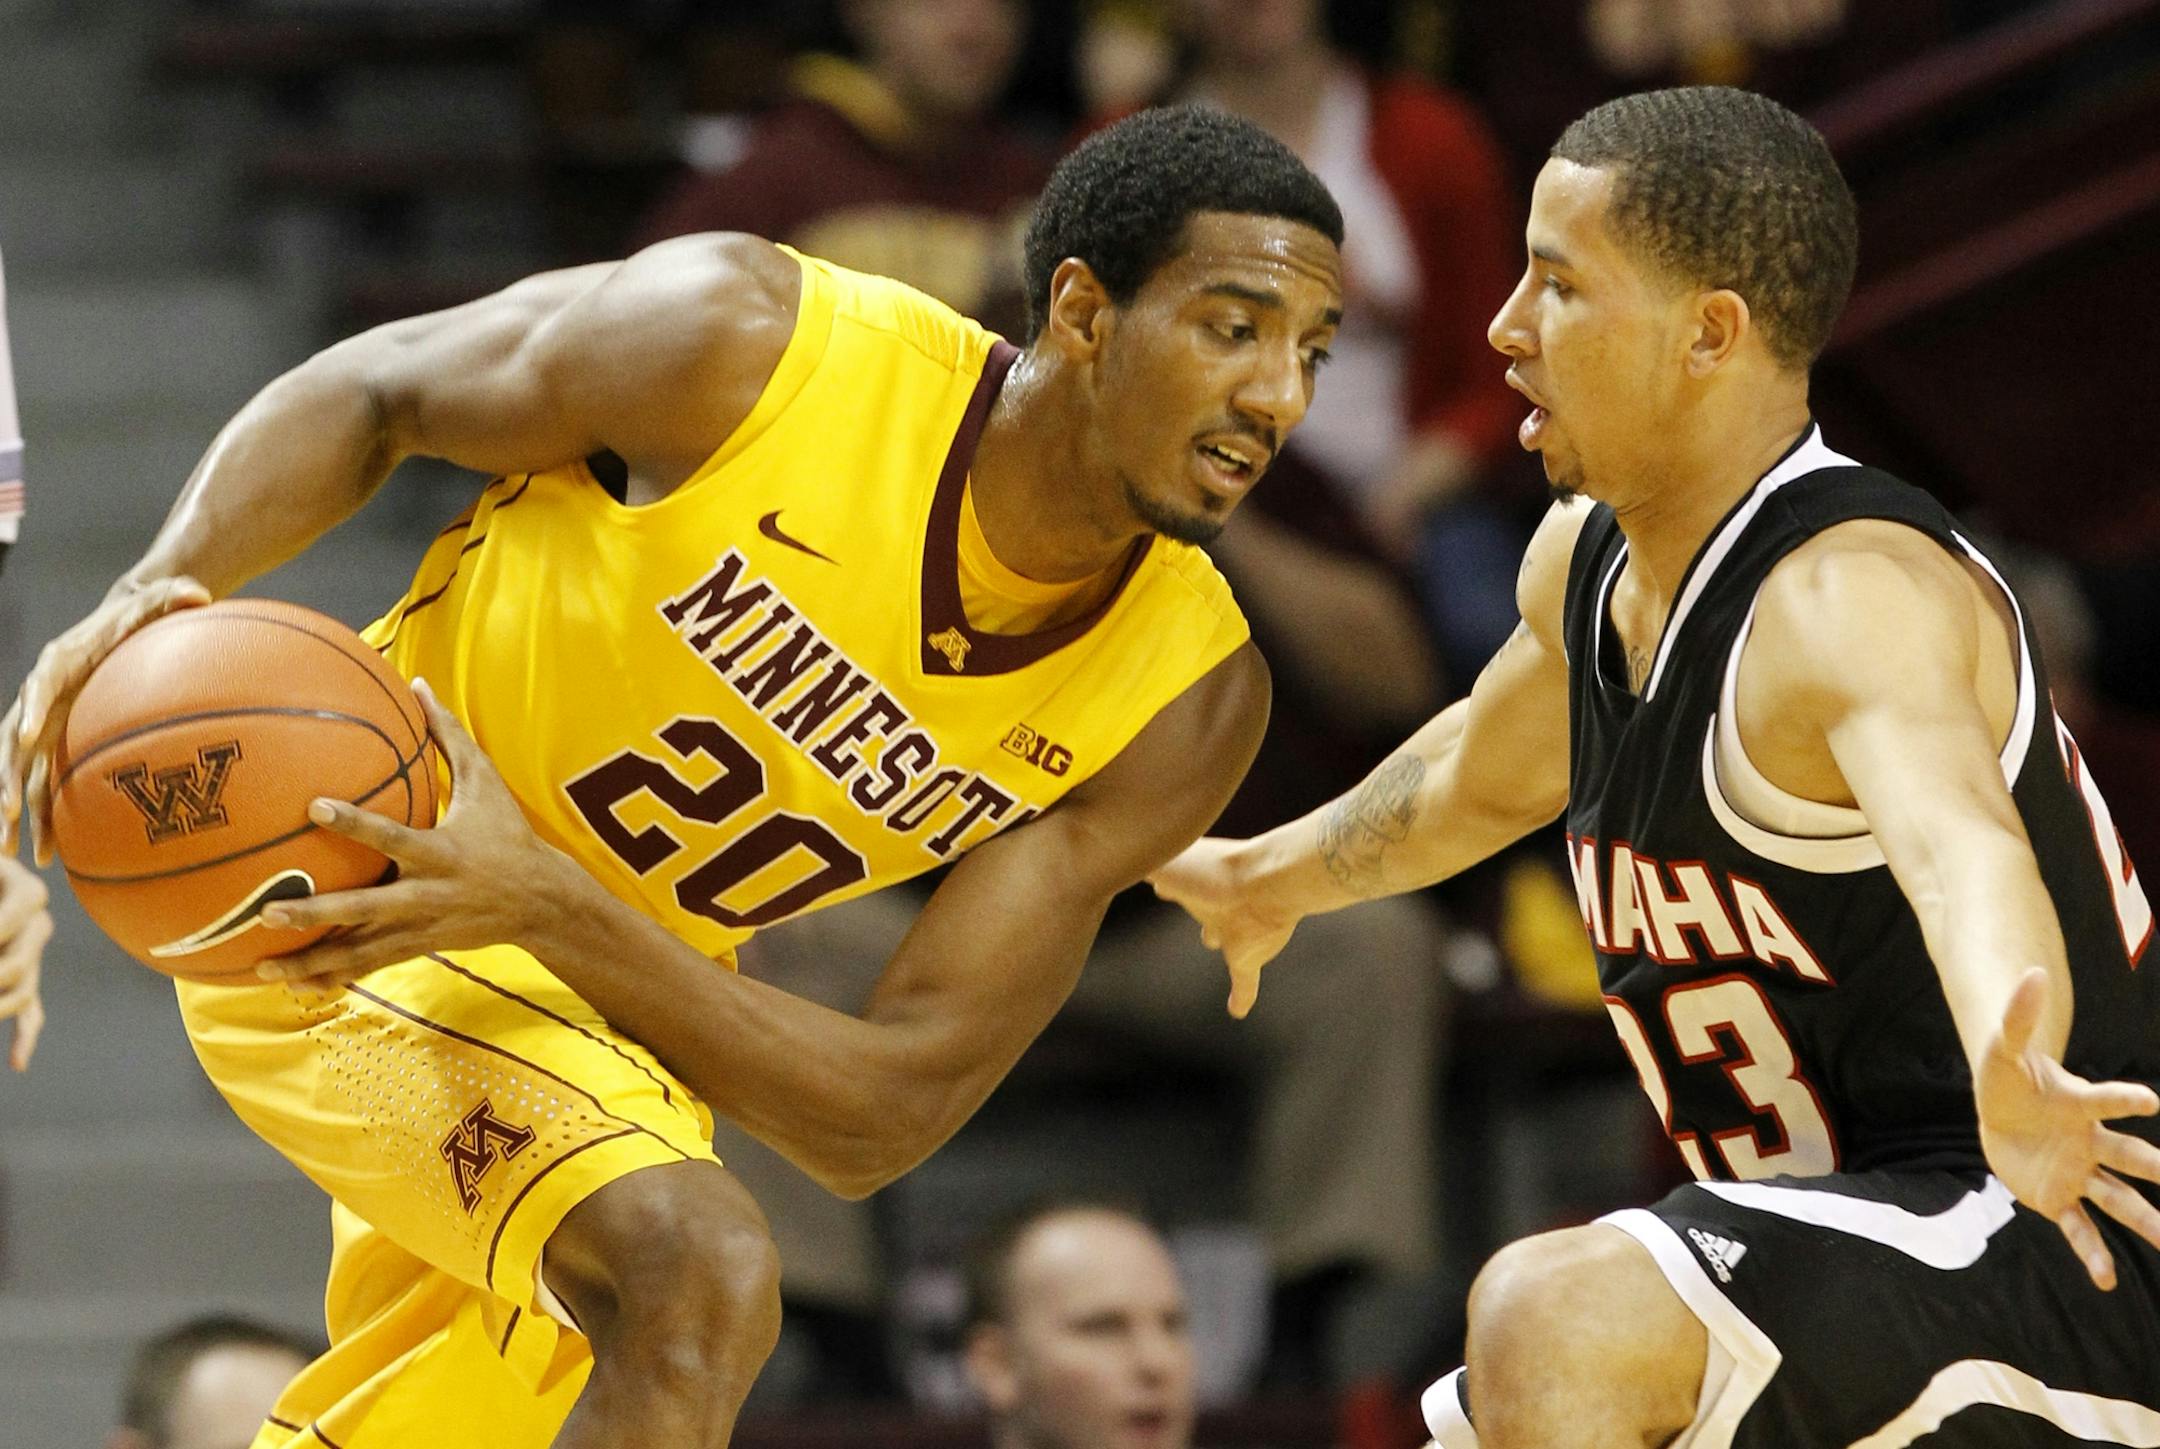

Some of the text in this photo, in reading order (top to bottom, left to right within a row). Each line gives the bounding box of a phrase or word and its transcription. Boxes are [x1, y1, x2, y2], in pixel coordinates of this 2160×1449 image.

[656, 545, 1044, 858] MINNESOT
[561, 714, 871, 928] 20
[1566, 832, 1837, 988] MAHA
[439, 1097, 537, 1218] M
